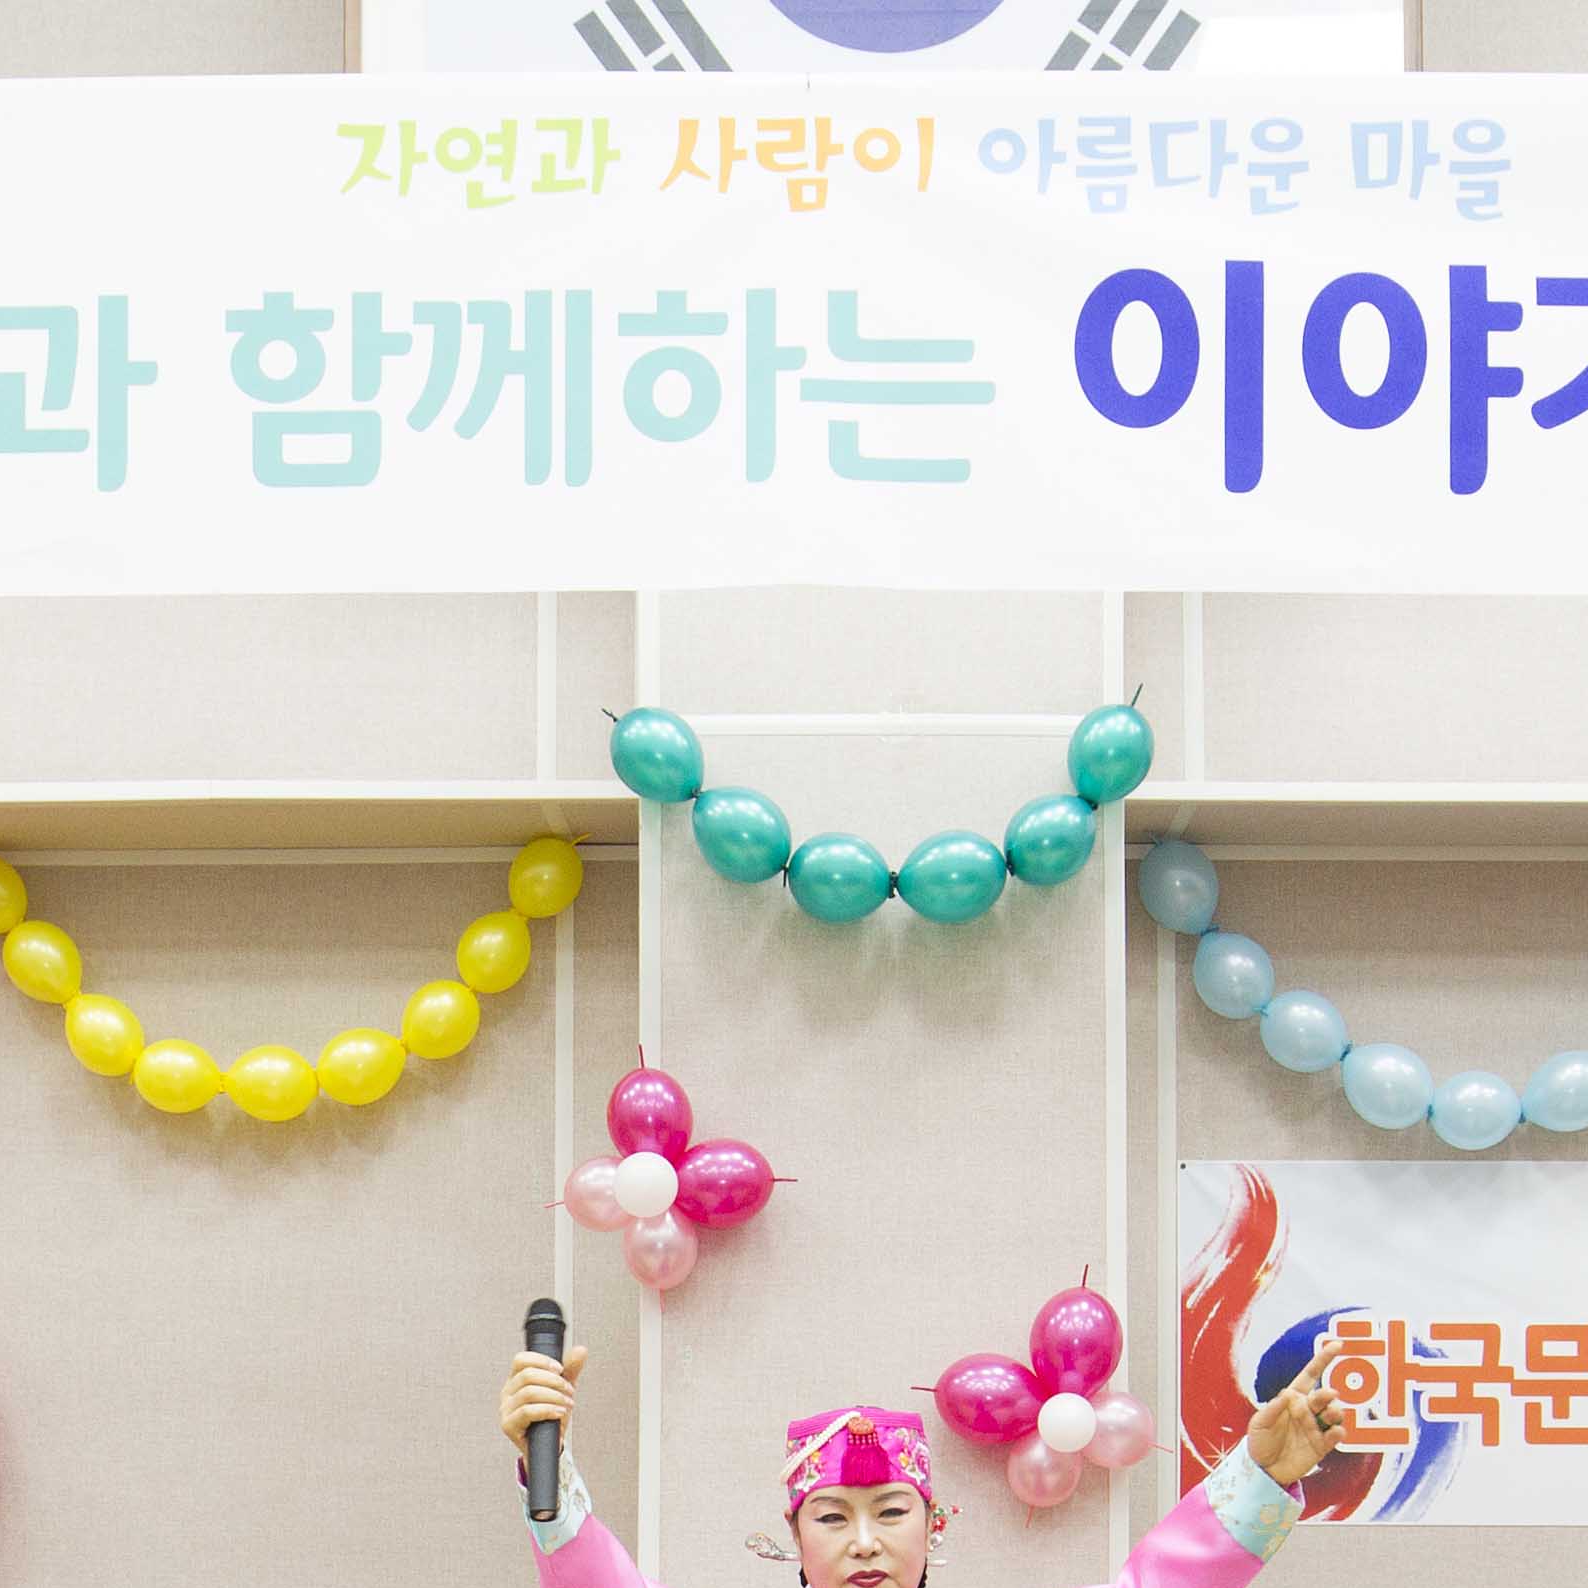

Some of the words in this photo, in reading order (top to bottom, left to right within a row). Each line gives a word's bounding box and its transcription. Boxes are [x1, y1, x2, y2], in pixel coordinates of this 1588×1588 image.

[336, 117, 621, 209] 자연과
[660, 116, 935, 213] 사람이
[978, 116, 1309, 217] 아름다운
[1351, 117, 1512, 221] 마을
[224, 288, 995, 487] 함께하는
